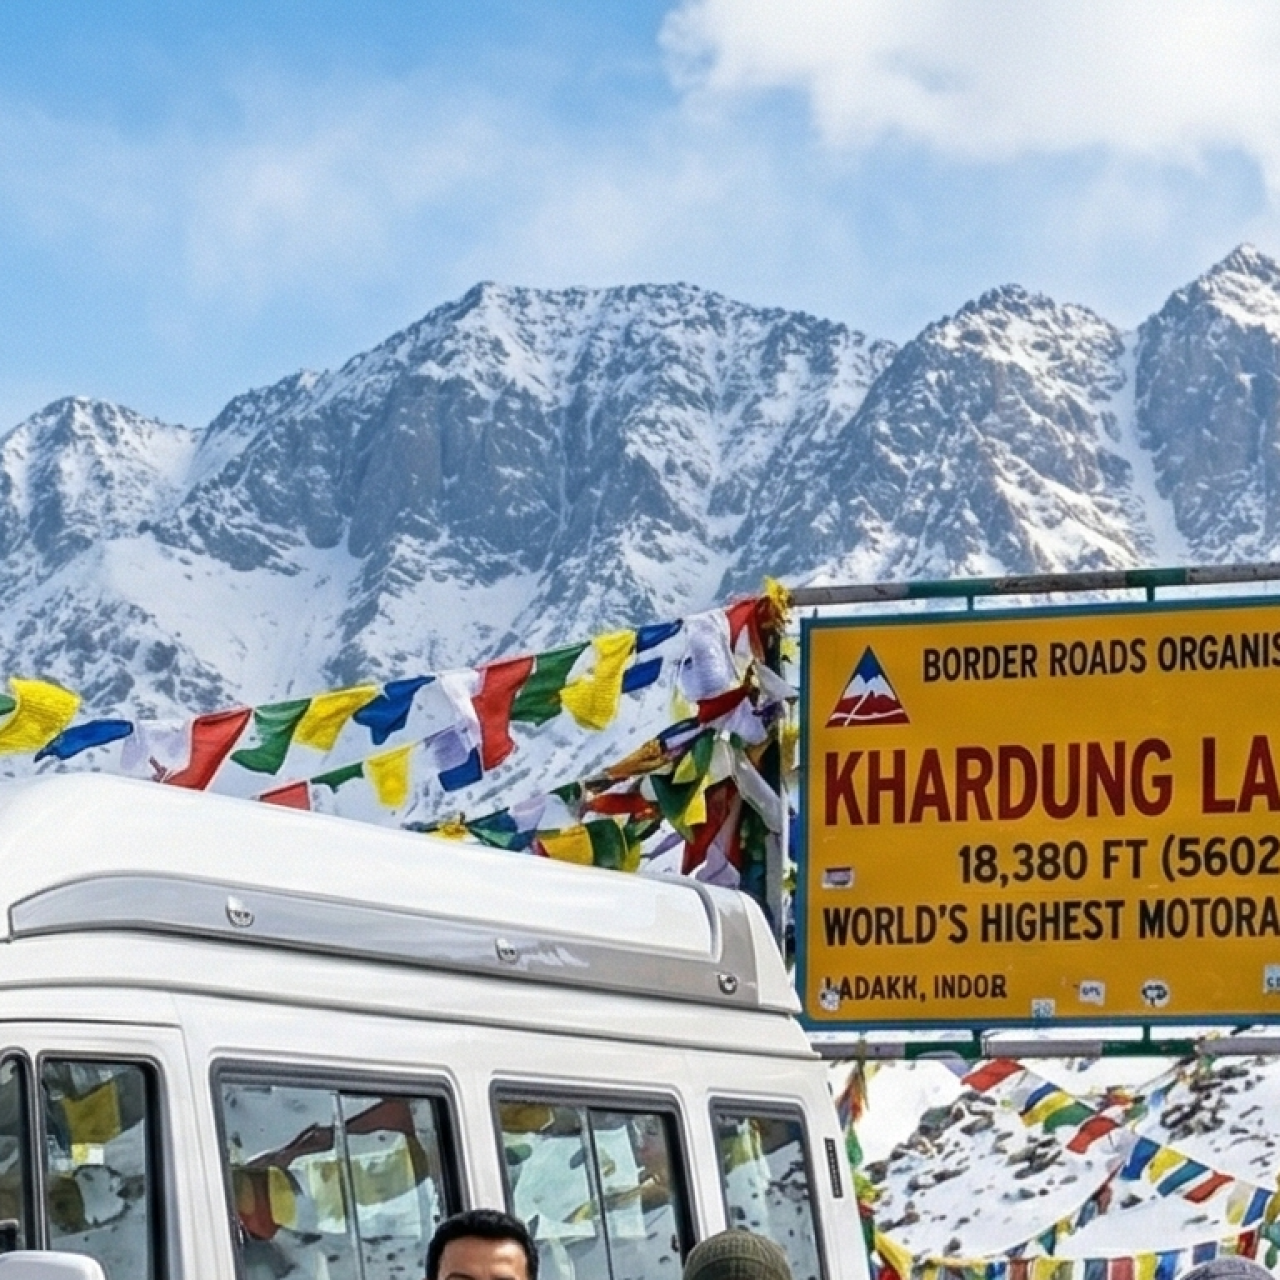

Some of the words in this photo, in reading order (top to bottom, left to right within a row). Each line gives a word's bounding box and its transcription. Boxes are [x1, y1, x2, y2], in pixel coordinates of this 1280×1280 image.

[923, 643, 1038, 683] BORDER
[1049, 637, 1147, 678] ROADS
[824, 737, 1174, 826] KHARDUNG
[1202, 734, 1280, 814] LA
[958, 840, 1088, 888] 18,380
[1102, 839, 1148, 879] FT
[1161, 834, 1280, 883] (5602
[822, 904, 969, 947] WORLD'S
[981, 899, 1126, 943] HIGHEST
[1139, 896, 1280, 939] MOTORA
